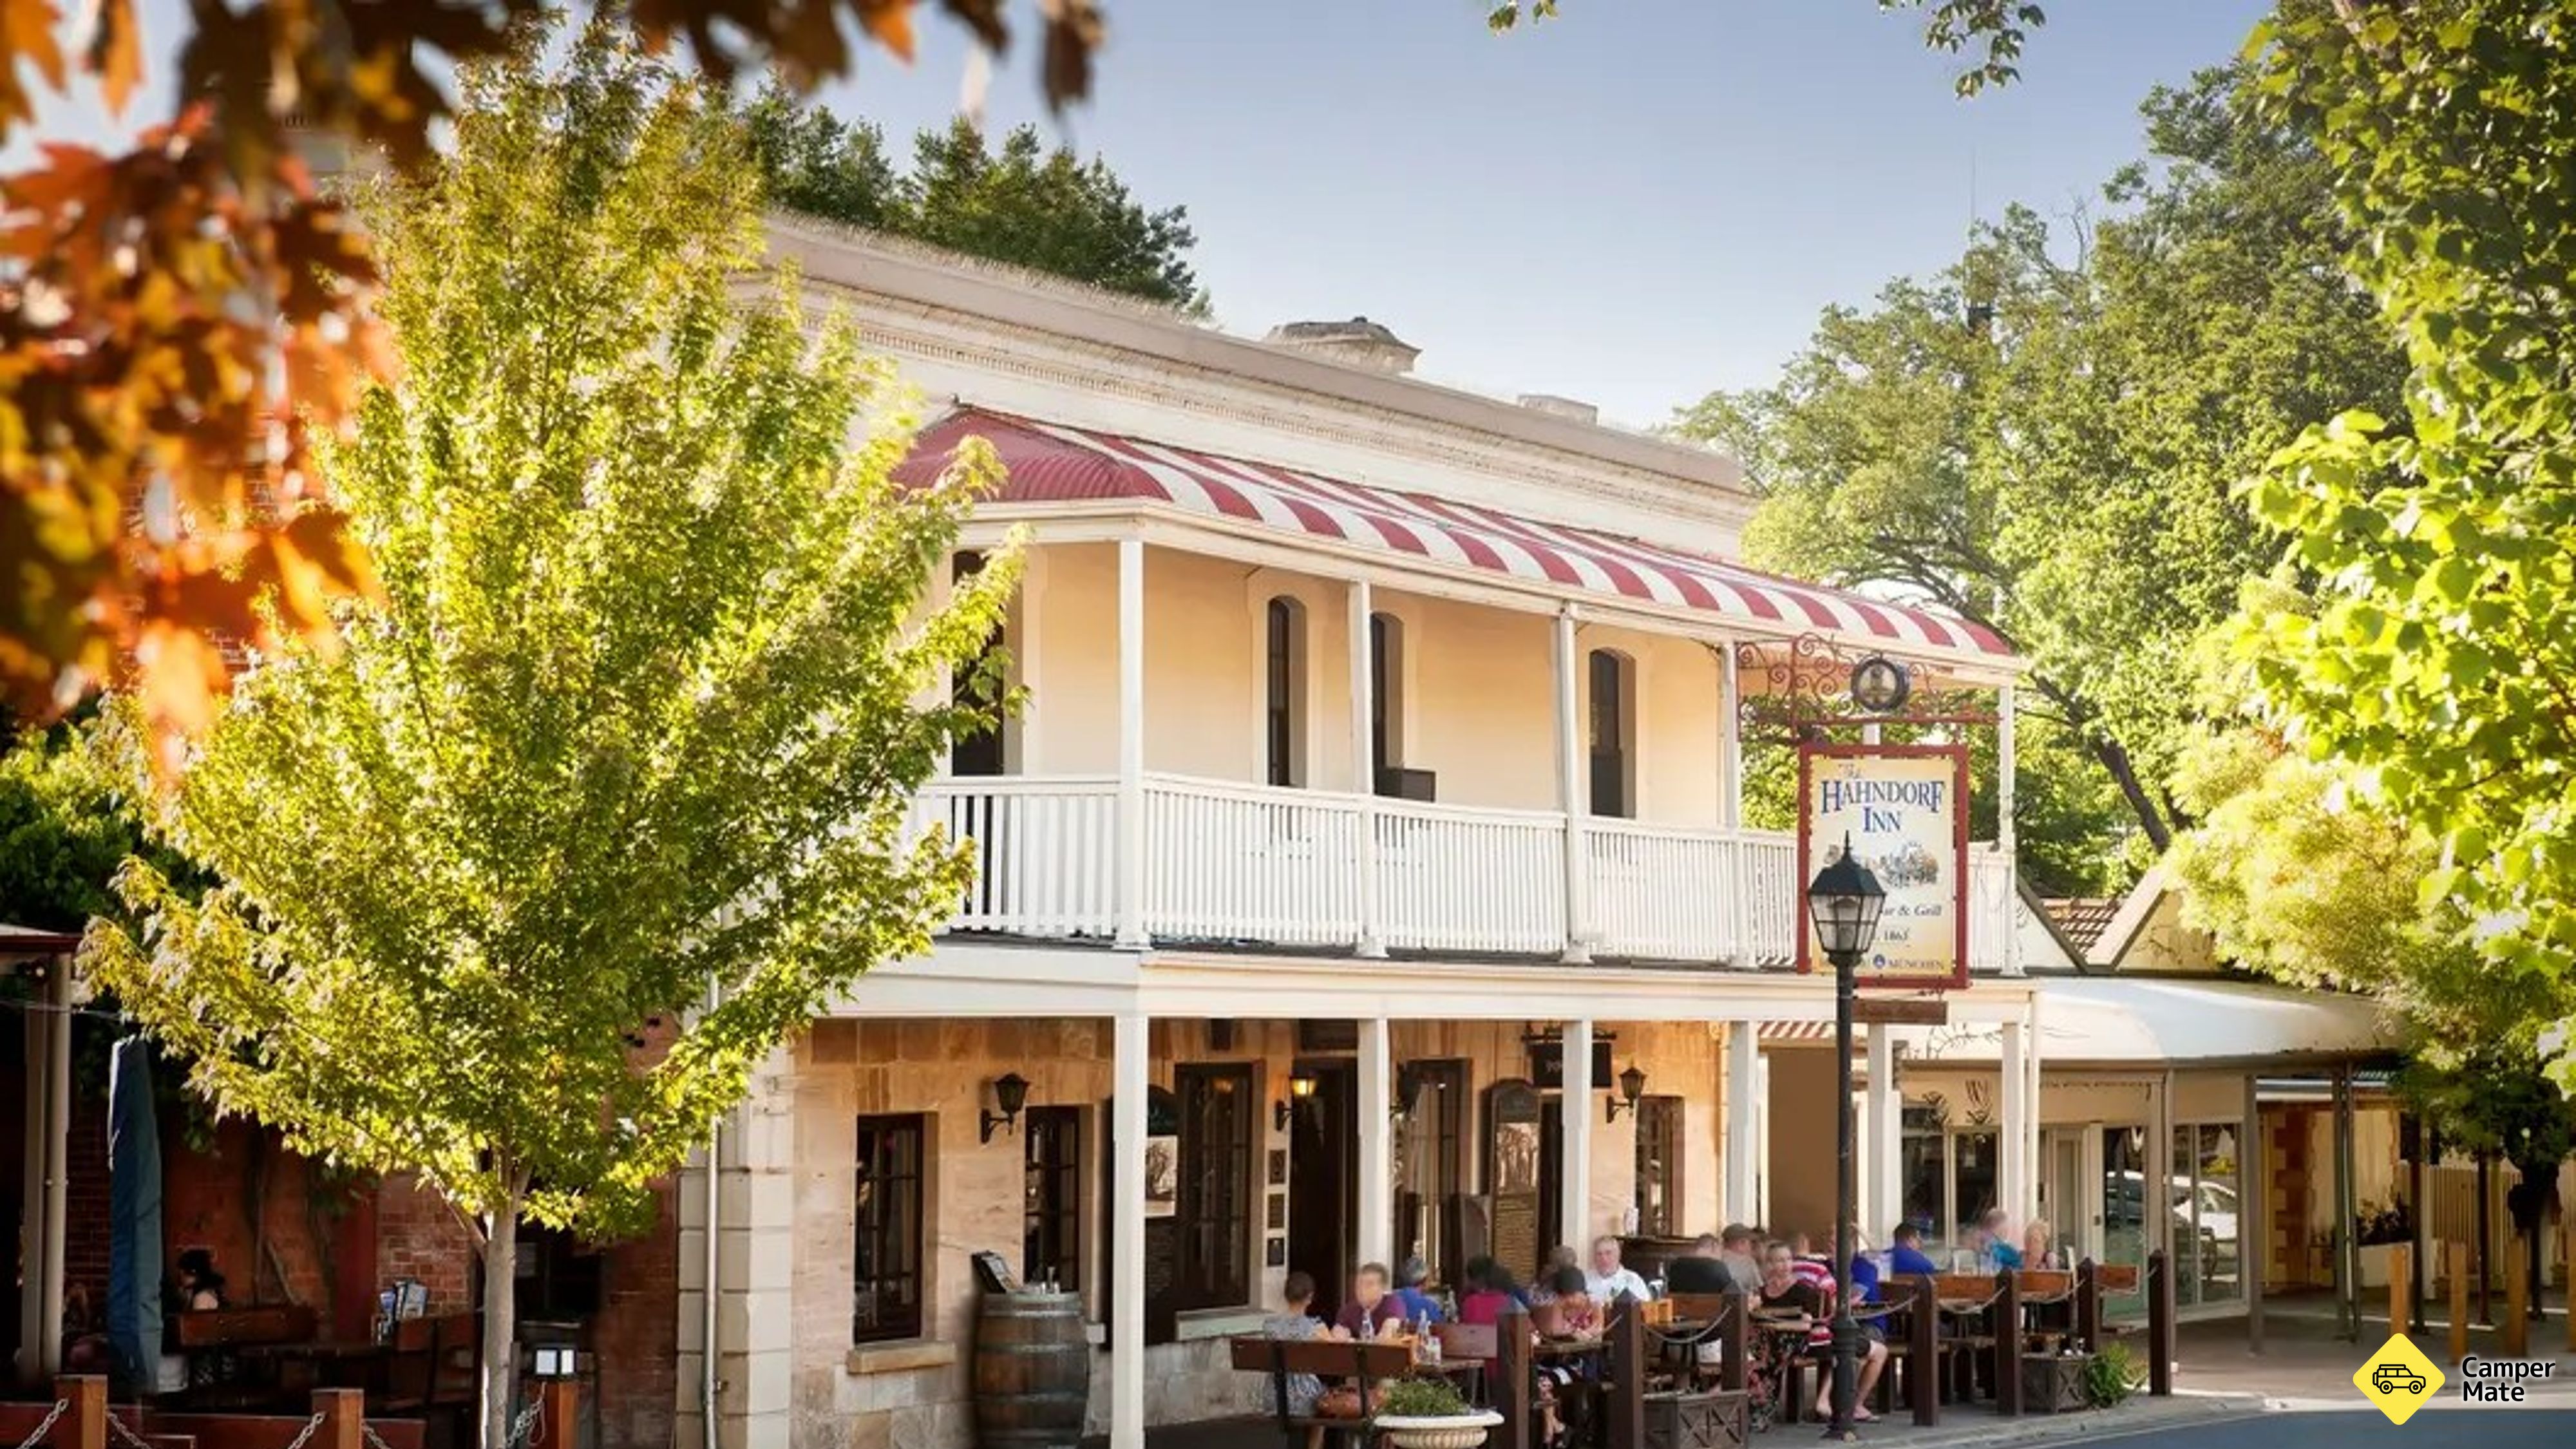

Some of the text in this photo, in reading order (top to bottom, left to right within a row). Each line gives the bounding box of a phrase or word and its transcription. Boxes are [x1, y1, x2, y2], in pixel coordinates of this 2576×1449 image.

[1821, 781, 1946, 813] HAHNDORF
[1863, 806, 1901, 833] INN
[1899, 905, 1911, 916] &
[1914, 904, 1942, 916] Grill
